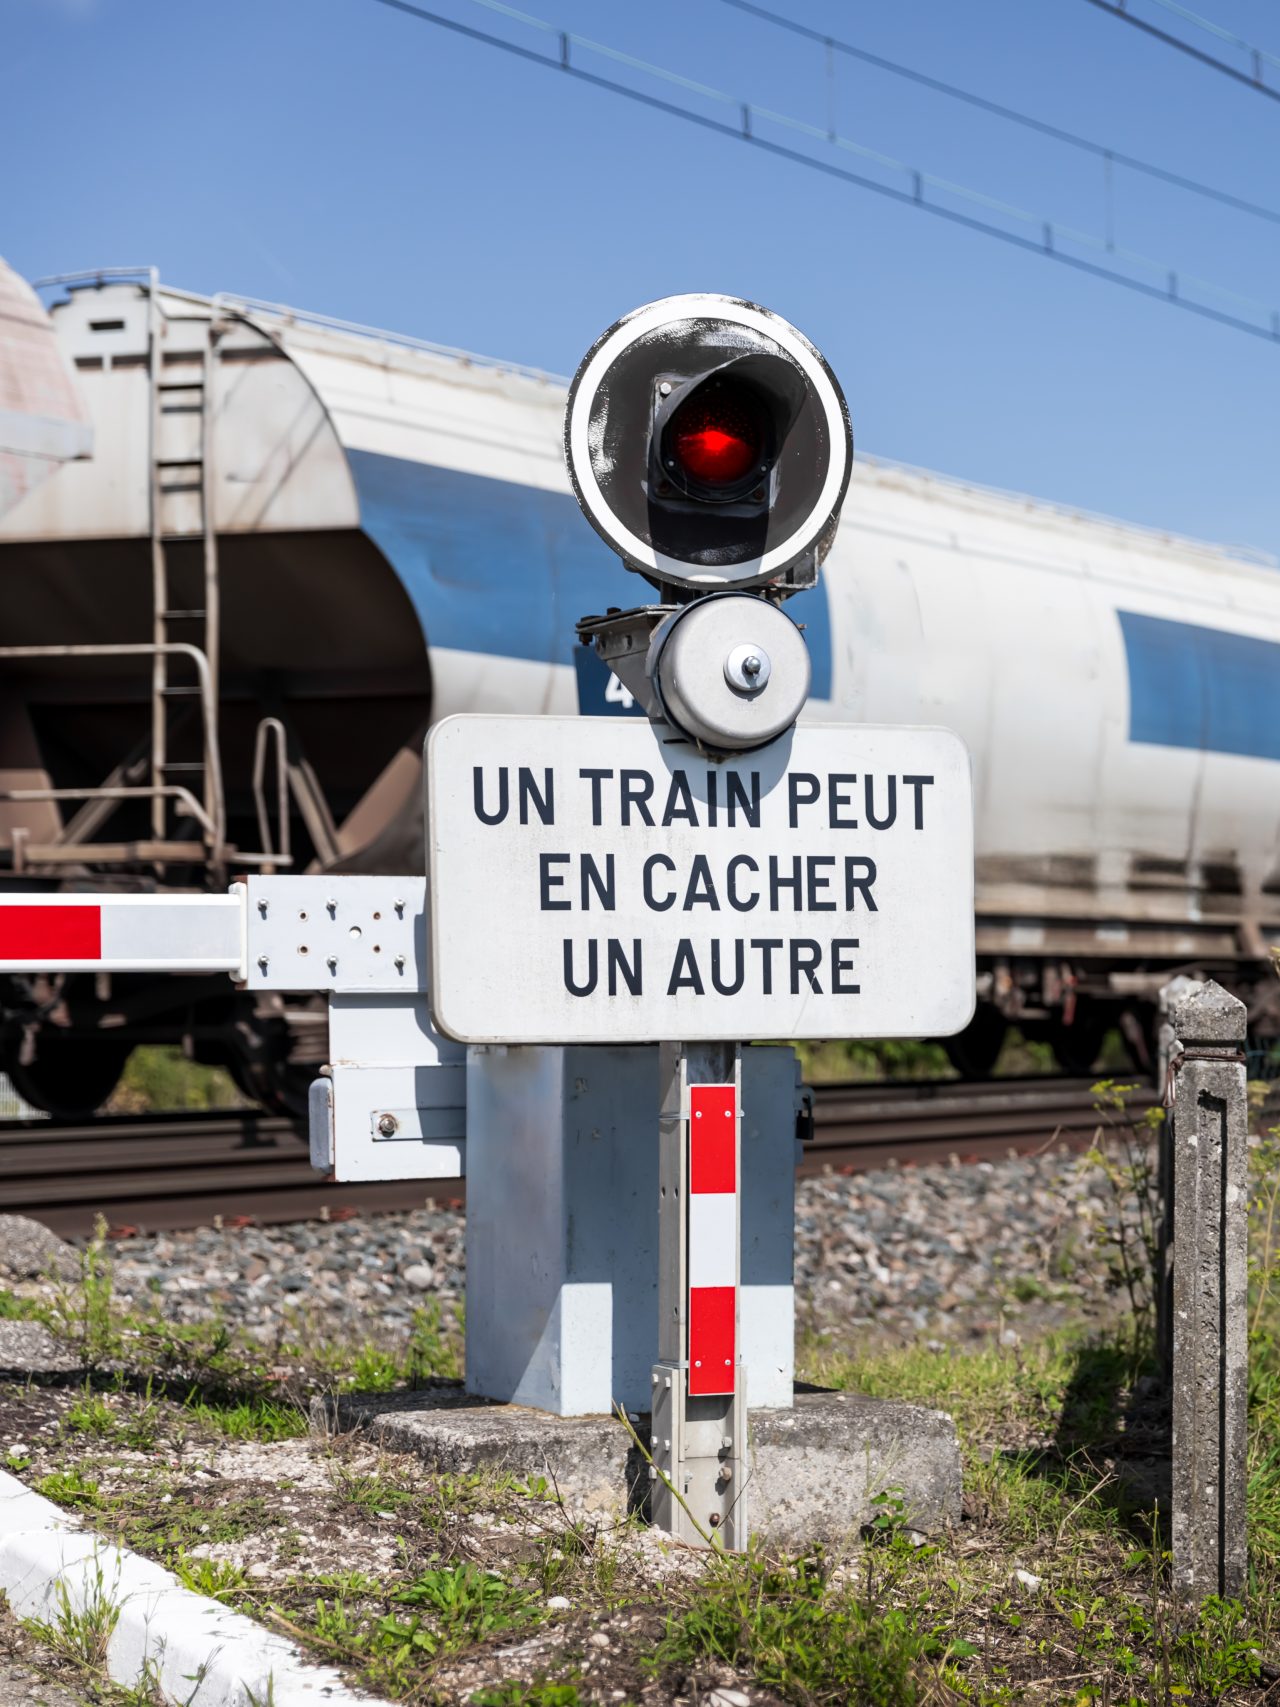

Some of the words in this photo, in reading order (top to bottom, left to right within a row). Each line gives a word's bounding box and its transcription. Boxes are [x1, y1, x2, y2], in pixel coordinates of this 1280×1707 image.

[473, 766, 555, 826] UN
[579, 768, 761, 828] TRAIN
[788, 772, 935, 831] PEUT
[539, 853, 616, 911] EN
[643, 854, 879, 912] CACHER
[563, 938, 643, 998] UN
[667, 938, 861, 996] AUTRE
